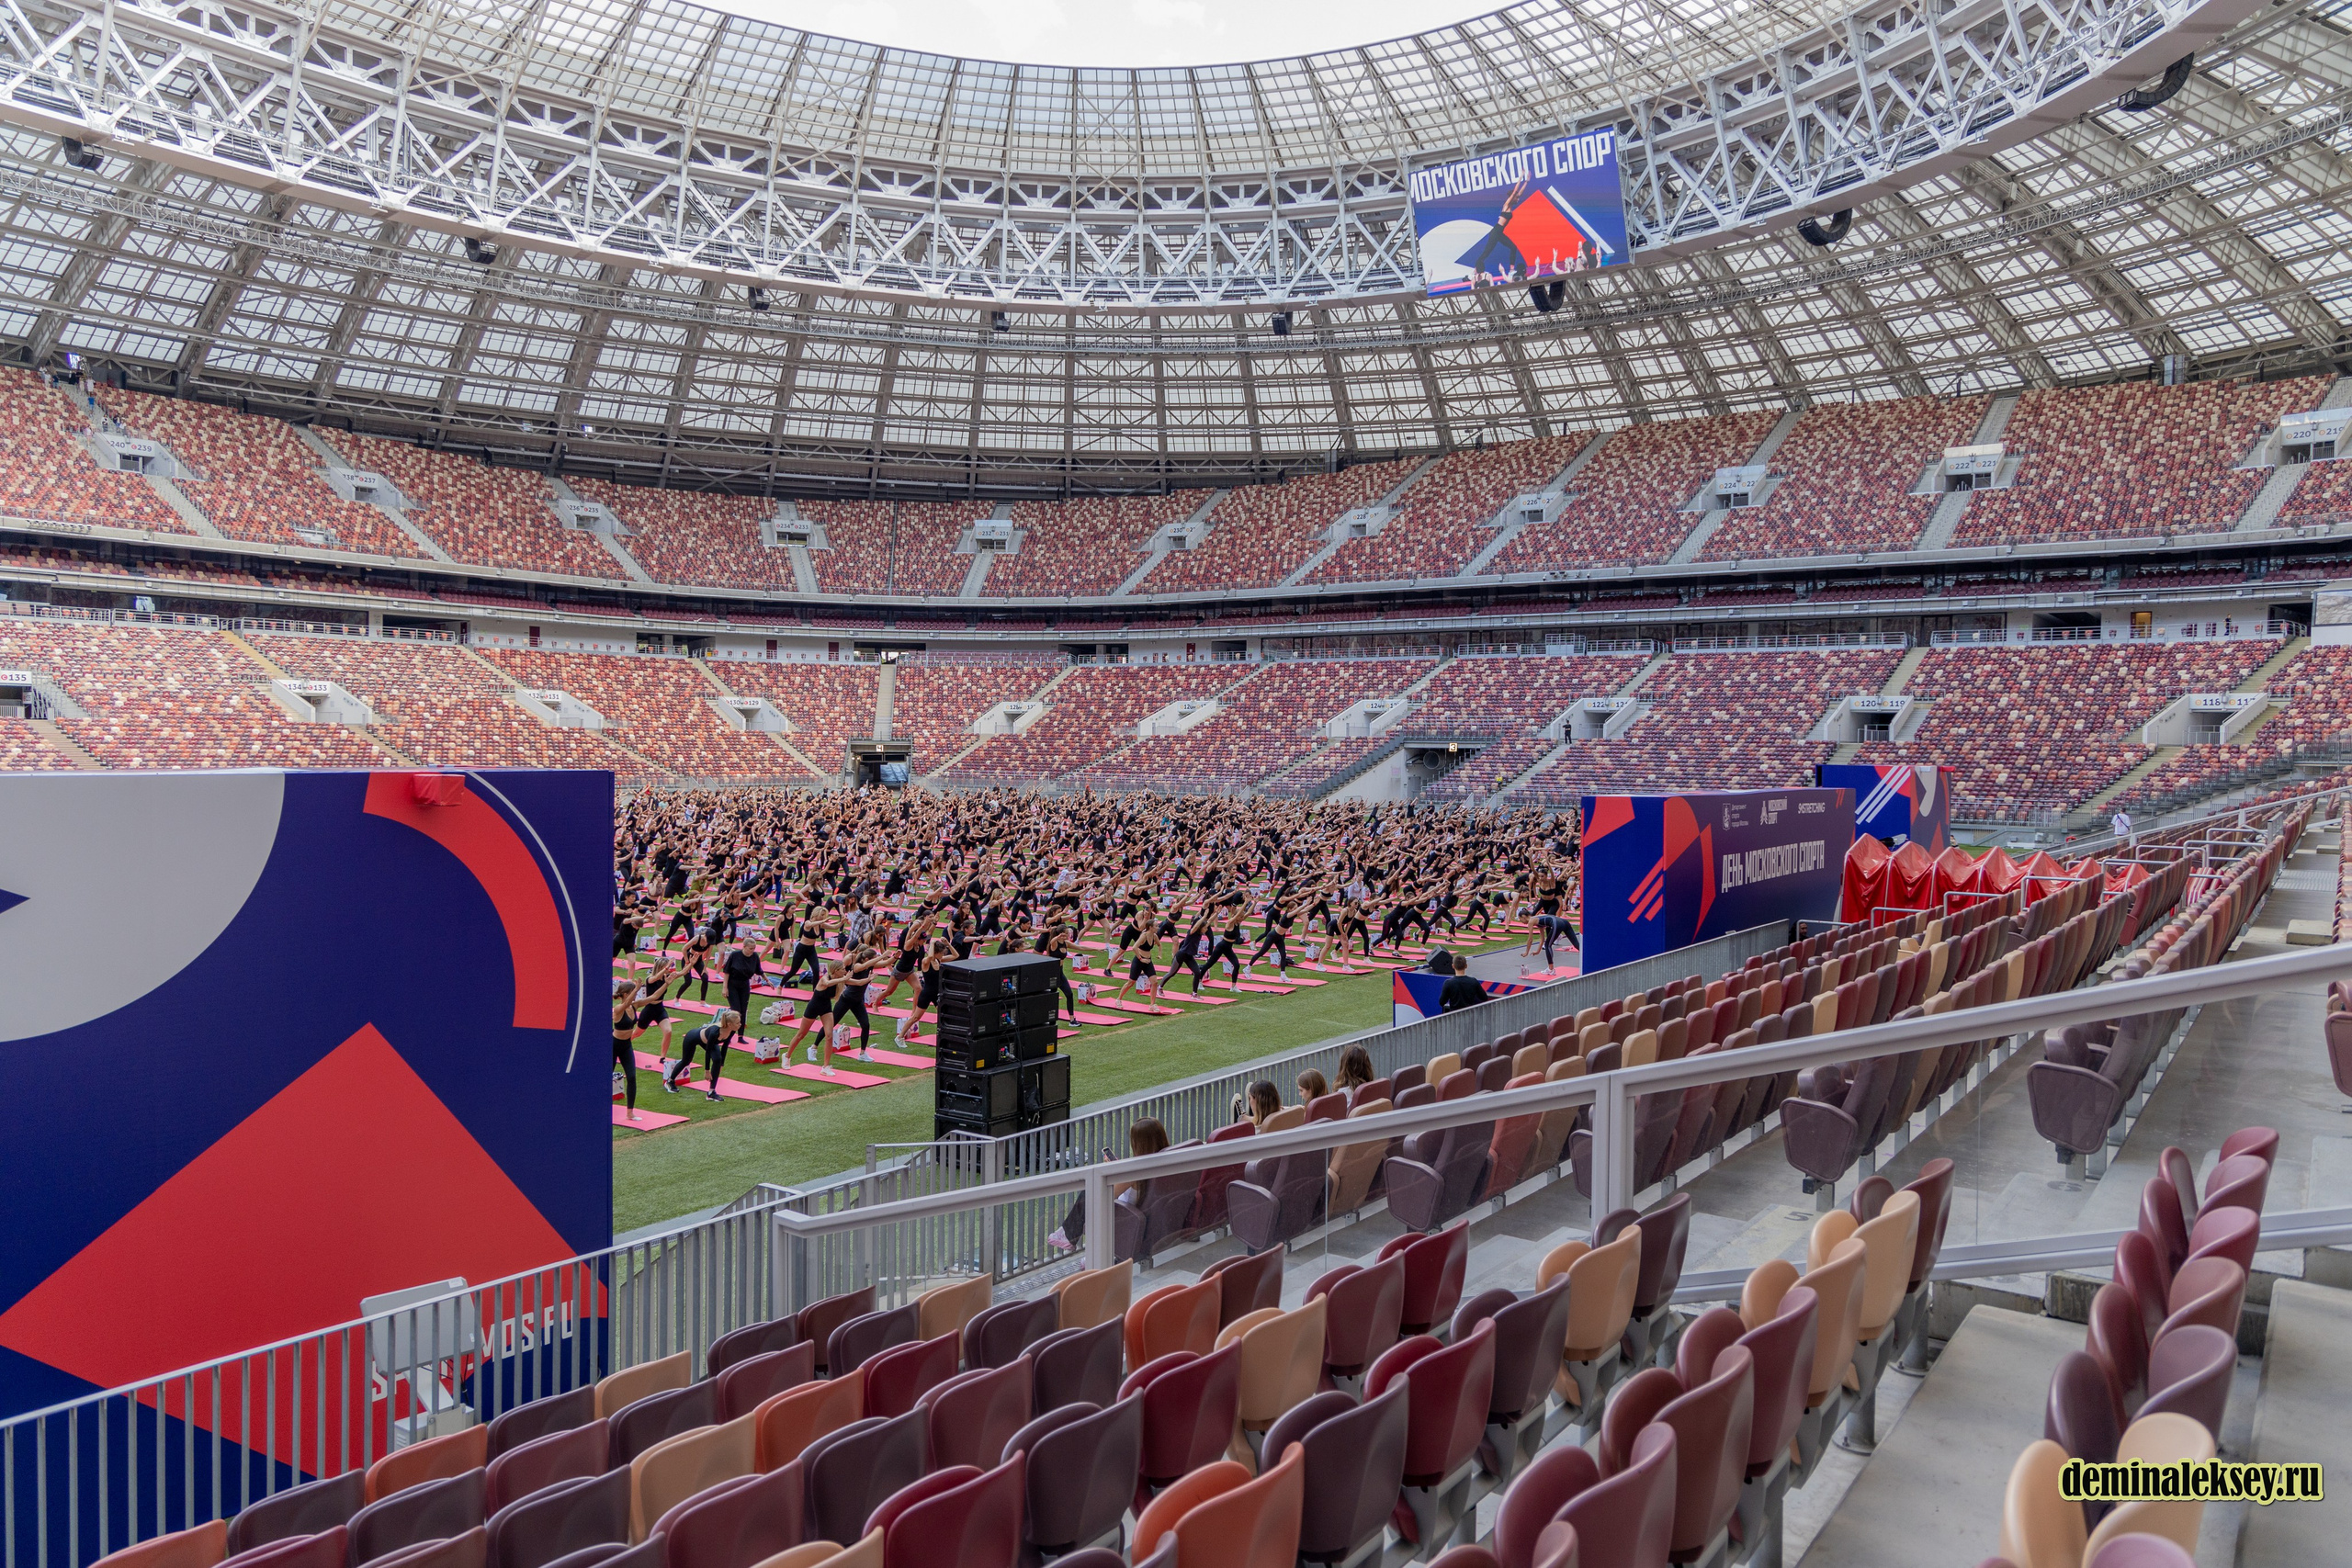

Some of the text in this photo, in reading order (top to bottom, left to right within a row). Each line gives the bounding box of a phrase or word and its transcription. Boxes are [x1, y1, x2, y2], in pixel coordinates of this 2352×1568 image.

[138, 444, 152, 452] 239
[2237, 697, 2256, 705] 11
[1722, 840, 1825, 893] ДЕНЬ МОСКОВСКОГО СПОРТА
[1784, 1211, 1814, 1221] 5
